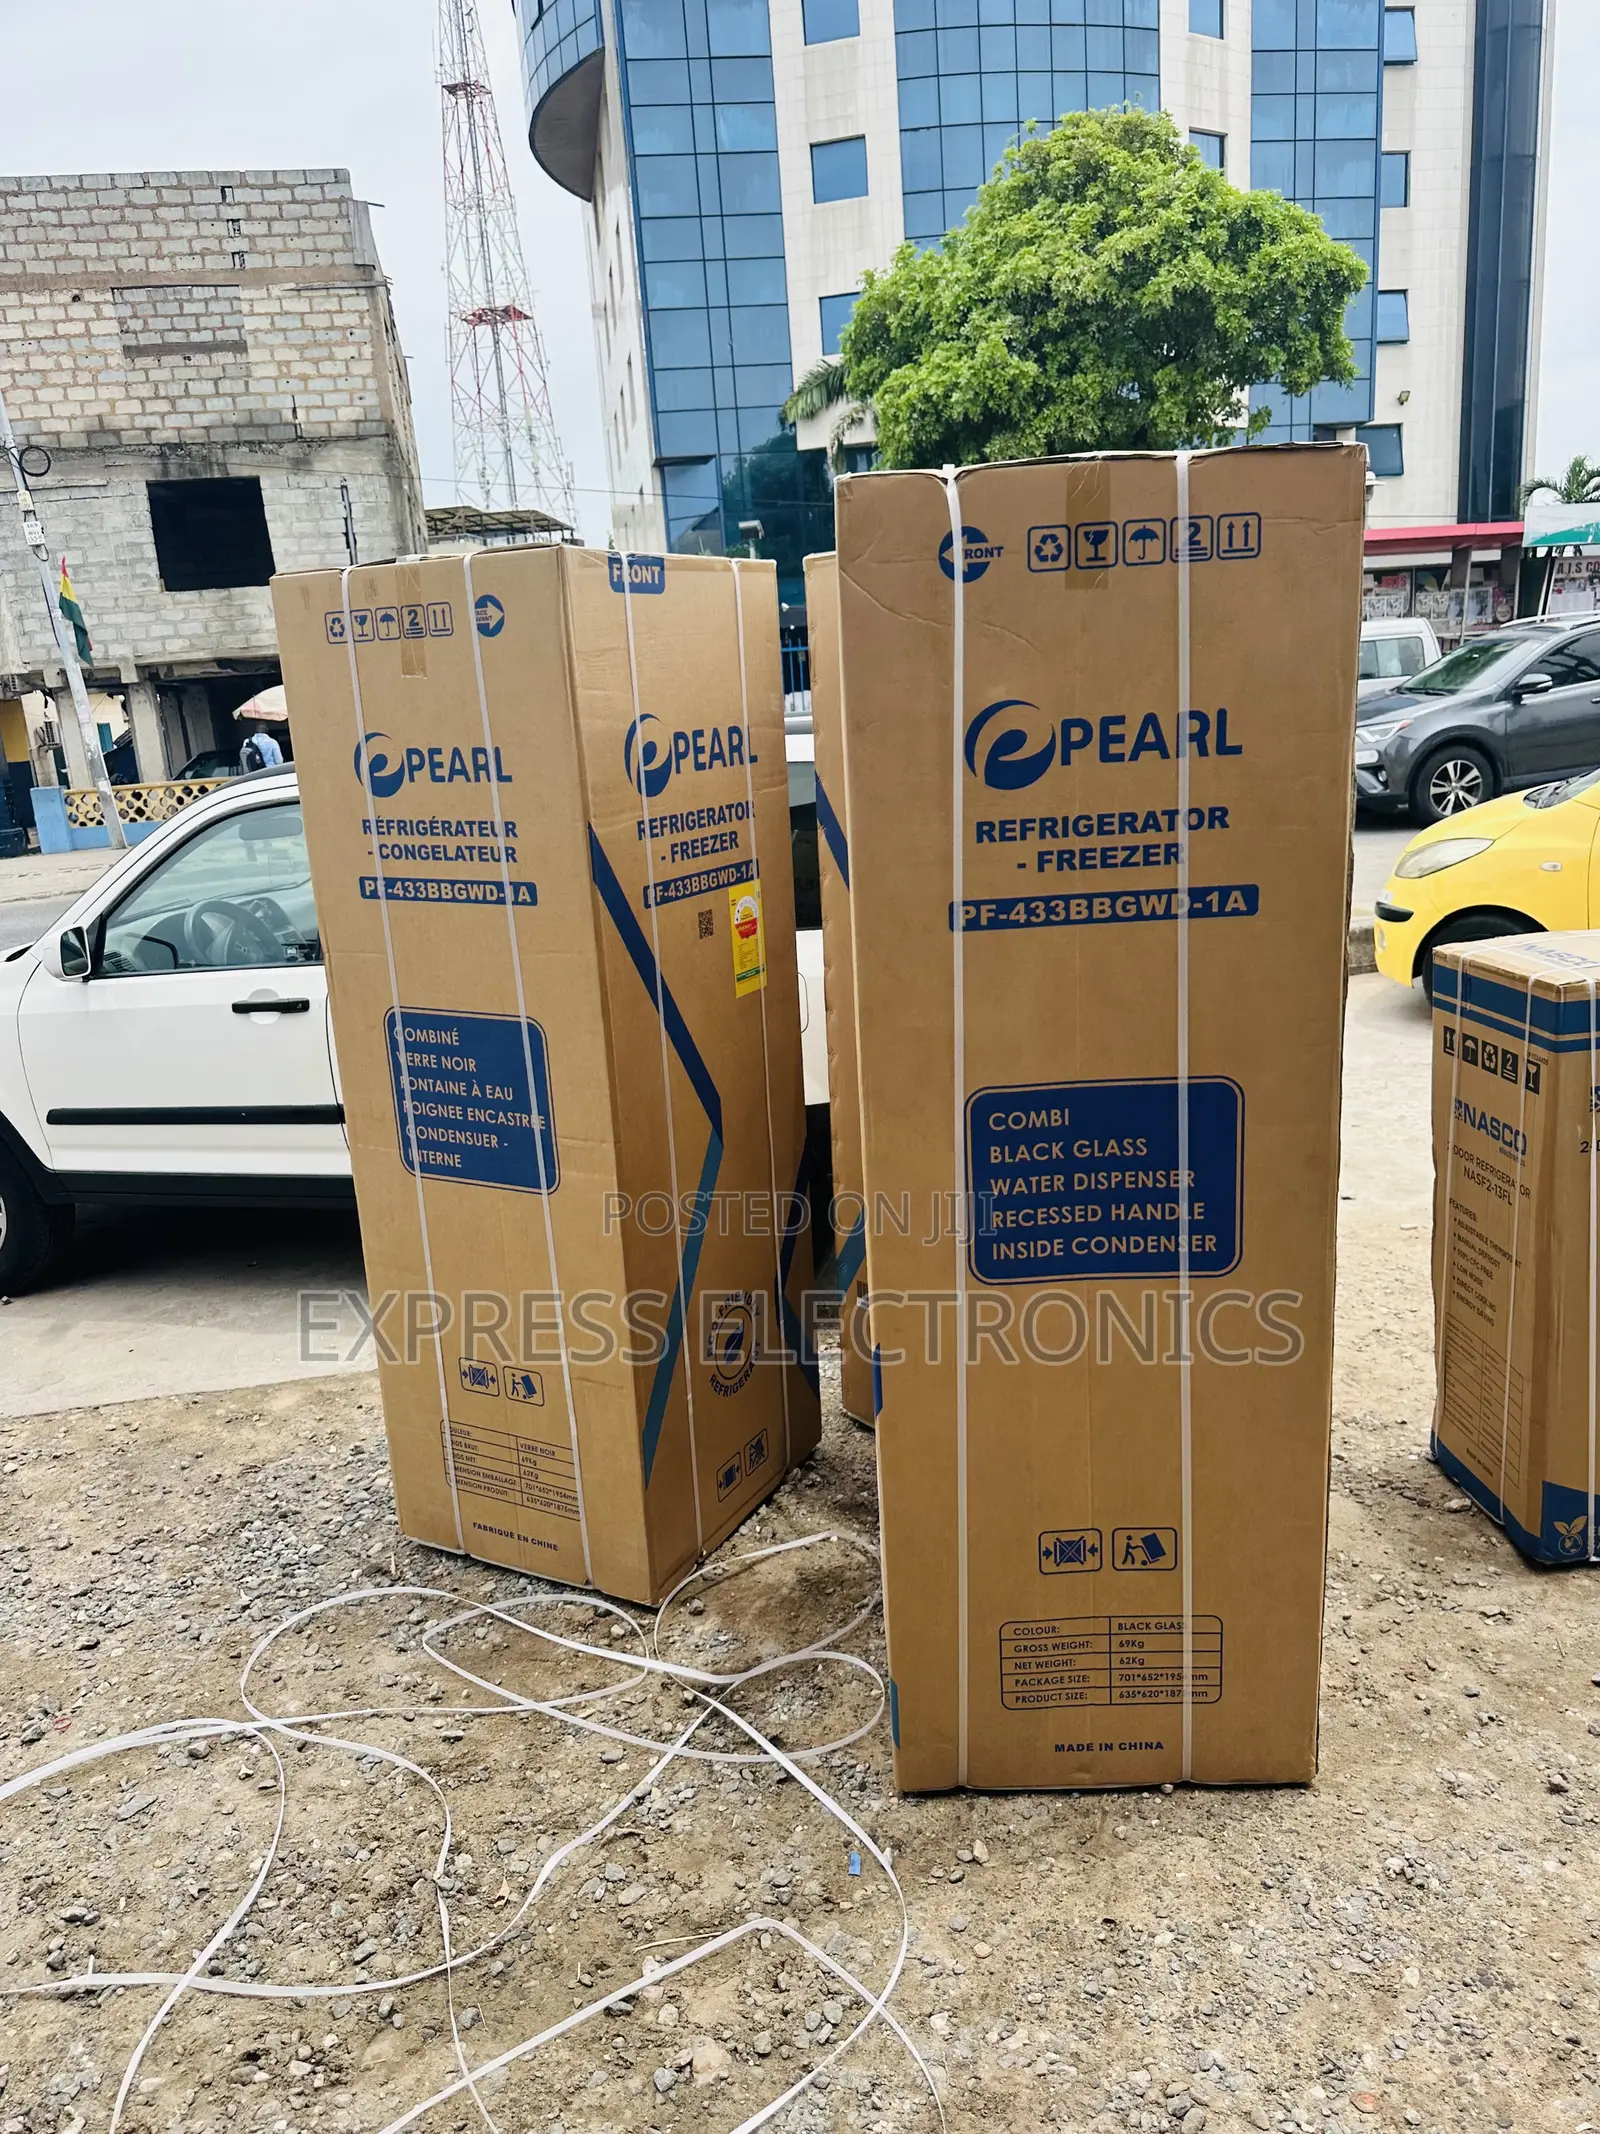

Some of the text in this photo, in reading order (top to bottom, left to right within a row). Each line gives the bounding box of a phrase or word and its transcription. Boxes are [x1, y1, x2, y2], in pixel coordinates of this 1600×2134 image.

[963, 546, 1004, 560] RONT
[673, 725, 759, 774] PEARL
[1060, 708, 1243, 766] PEARL
[405, 746, 513, 783] PEARL
[361, 816, 518, 838] RÉFRIGÉRATEUR
[637, 800, 755, 841] REFRIGERATOR
[975, 806, 1230, 844] REFRIGERATOR
[379, 843, 518, 864] CONGELATEUR
[670, 830, 740, 864] FREEZER
[1037, 843, 1185, 873] FREEZER
[959, 889, 1248, 927] PF-433BBGWD-1A
[441, 1055, 477, 1073] NOIR
[471, 1079, 482, 1098] À
[486, 1085, 513, 1101] EAU
[988, 1107, 1070, 1131] COMBI
[1464, 1102, 1527, 1156] NASCO
[990, 1137, 1148, 1164] BLACK GLASS
[990, 1169, 1196, 1196] WATER DISPENSER
[1464, 1166, 1513, 1206] NASF2-13FL
[1476, 1156, 1531, 1199] REFRIGERAOR
[991, 1204, 1103, 1229] RECESSED
[992, 1234, 1217, 1260] INSIDE CONDENSER
[1489, 1240, 1522, 1269] THERMOSAT
[539, 1447, 557, 1457] NOIR
[517, 1534, 529, 1544] EN
[531, 1537, 559, 1551] CHINE
[1013, 1621, 1186, 1636] COLOUR: BLACK GLAS
[1013, 1639, 1145, 1653] GROSS WEIGHT: 69Kg
[1014, 1656, 1145, 1670] NET WEIGHT: 62Kg
[1014, 1676, 1065, 1687] PACKAGE
[1067, 1674, 1090, 1684] SIZE:
[1015, 1692, 1062, 1704] PRODUCT
[1065, 1691, 1088, 1700] SIZE:
[1054, 1741, 1164, 1752] MADE IN CHINA
